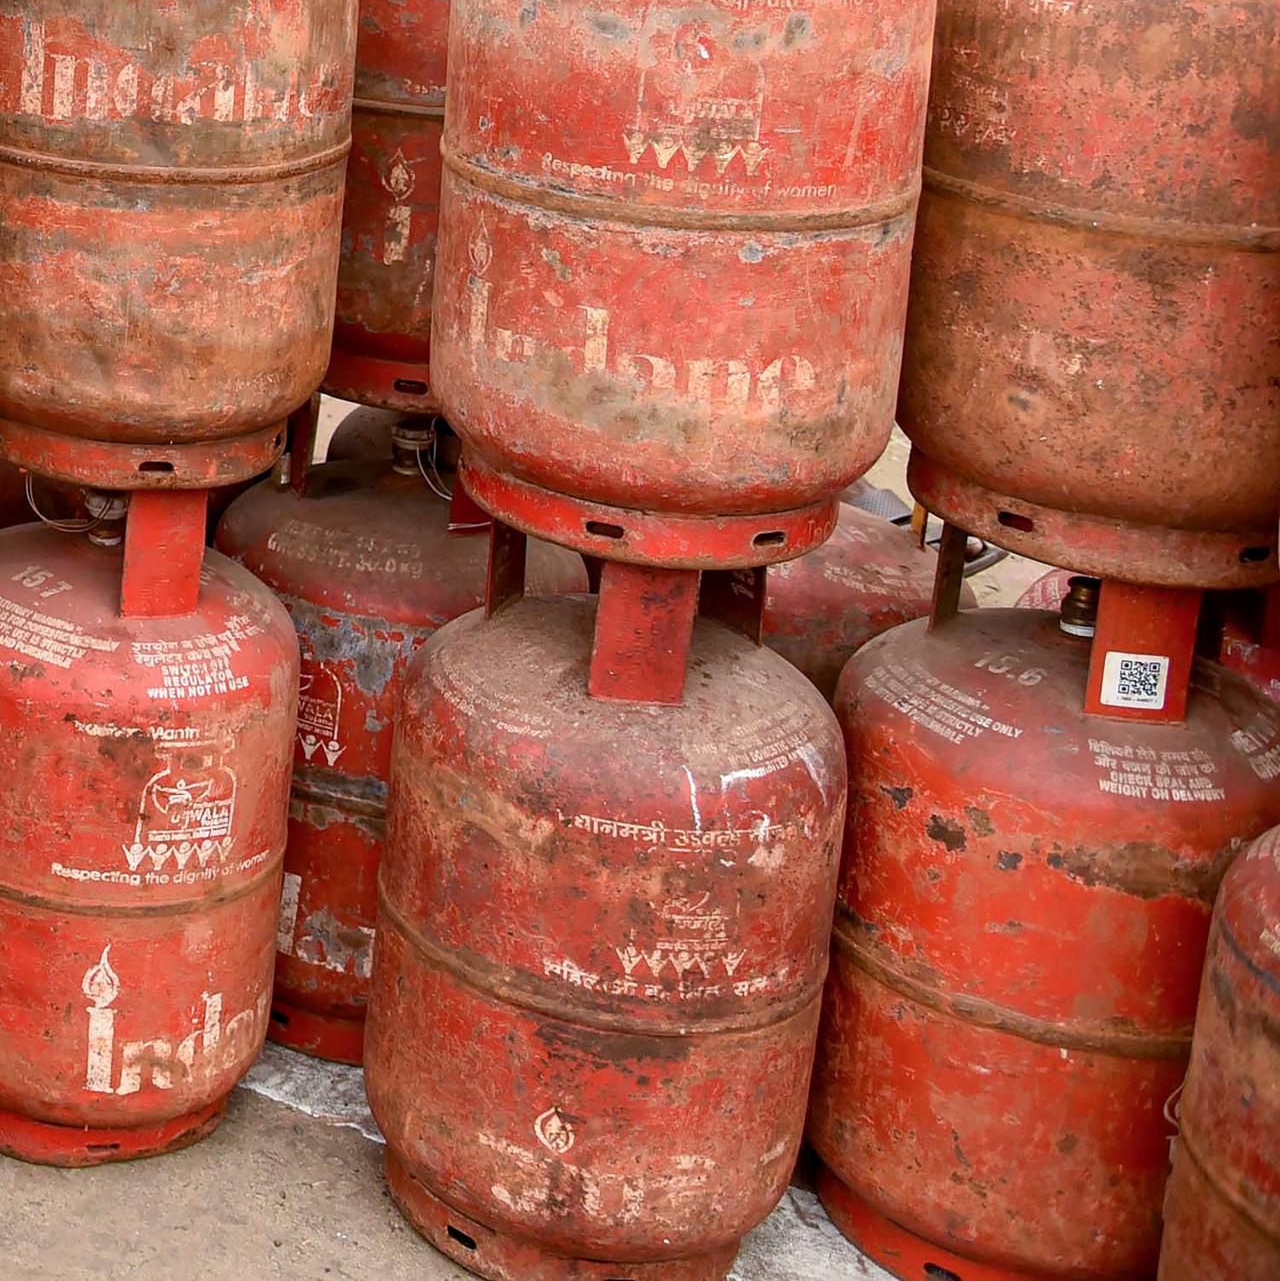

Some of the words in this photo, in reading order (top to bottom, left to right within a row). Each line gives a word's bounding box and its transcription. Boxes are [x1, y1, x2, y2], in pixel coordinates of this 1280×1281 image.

[147, 687, 185, 699] WHEN
[188, 685, 212, 698] NOT
[214, 682, 227, 694] IN
[229, 675, 250, 691] USE
[991, 721, 1024, 738] ONLY
[1099, 780, 1149, 799] WEIGHT
[51, 862, 142, 887] Respecting
[144, 872, 170, 885] the
